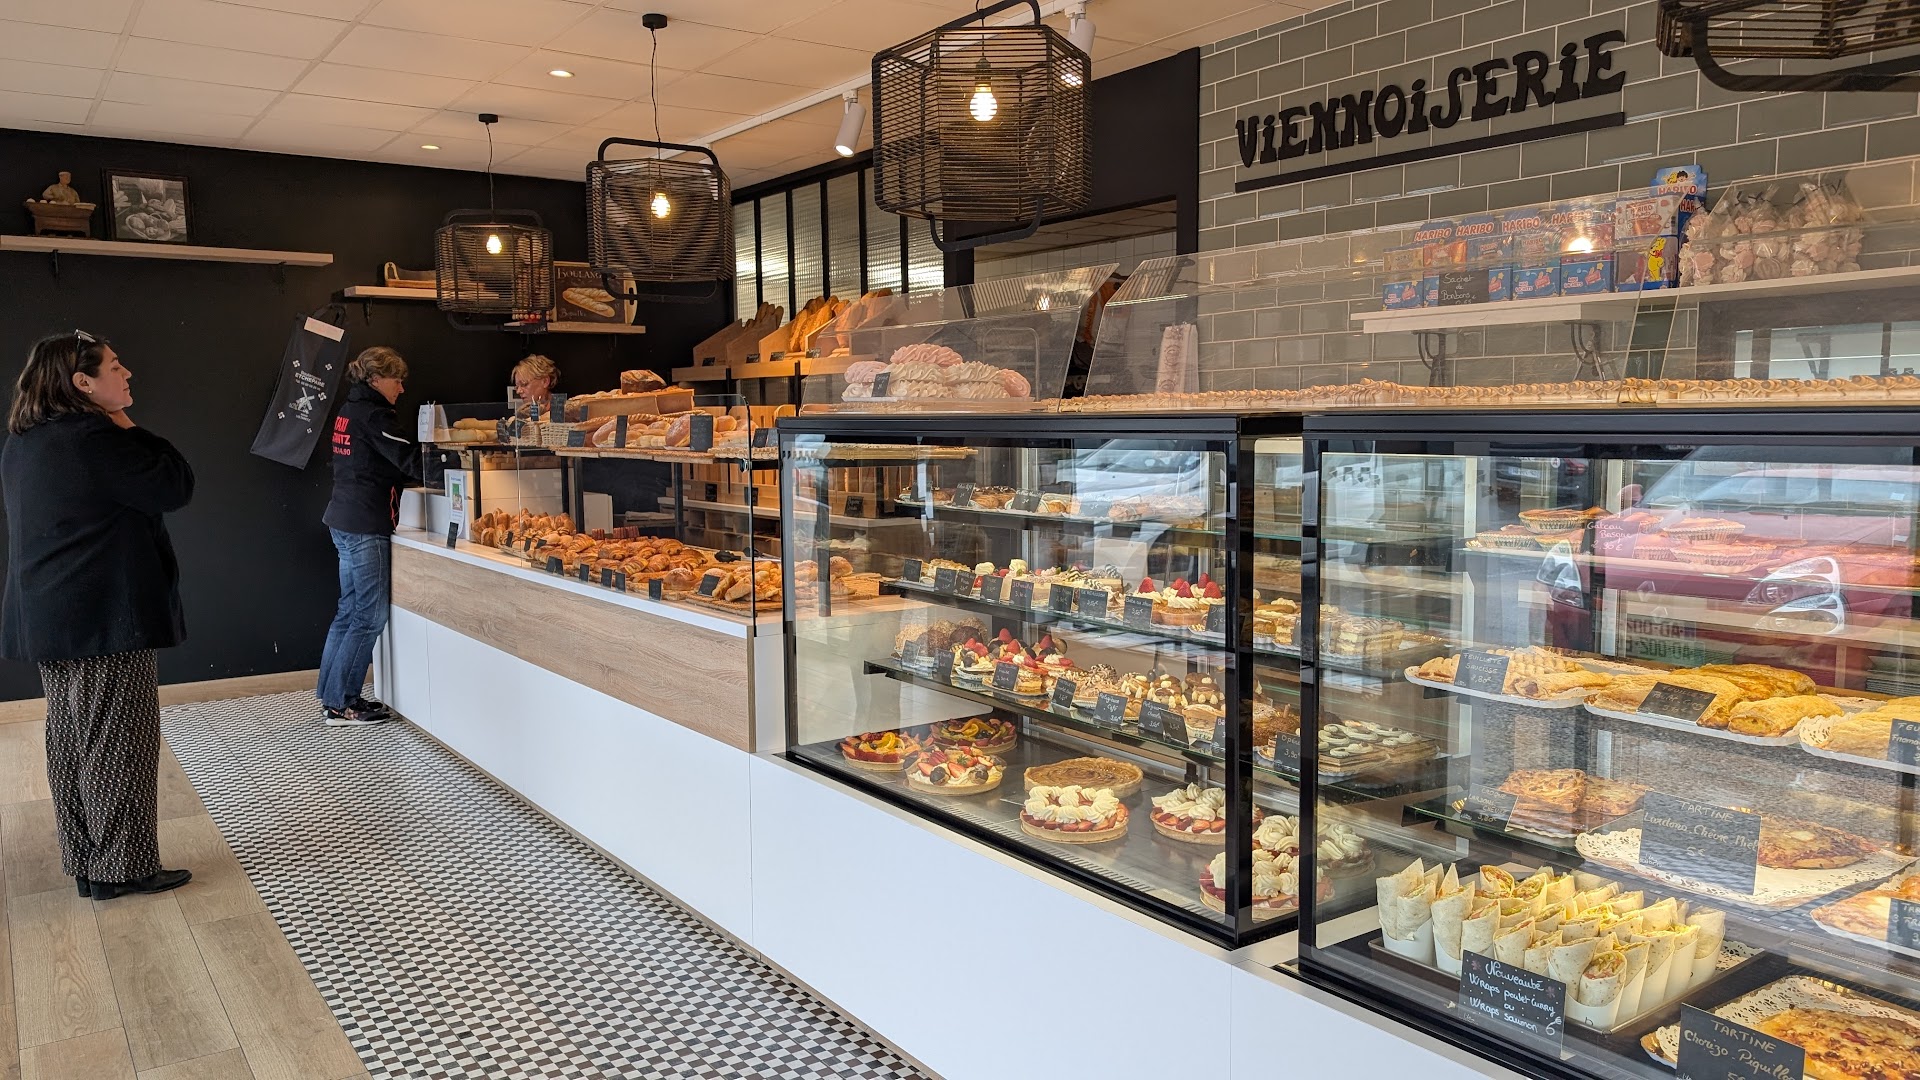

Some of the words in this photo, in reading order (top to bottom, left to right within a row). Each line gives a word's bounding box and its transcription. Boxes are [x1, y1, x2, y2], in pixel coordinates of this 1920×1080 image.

[1456, 222, 1494, 236] HARIBO
[1502, 216, 1541, 232] HARIBO
[1414, 228, 1452, 241] HARIBO
[1443, 273, 1475, 284] Sachet
[1441, 290, 1470, 300] Bonbons
[1675, 800, 1734, 823] TARTINE
[1485, 960, 1544, 991] Nouveauté
[1504, 989, 1531, 1004] poulet
[1504, 1003, 1515, 1011] ou
[1504, 1013, 1538, 1033] saumon
[1684, 1030, 1728, 1057] Chorizo
[1711, 1019, 1777, 1054] TARTINE
